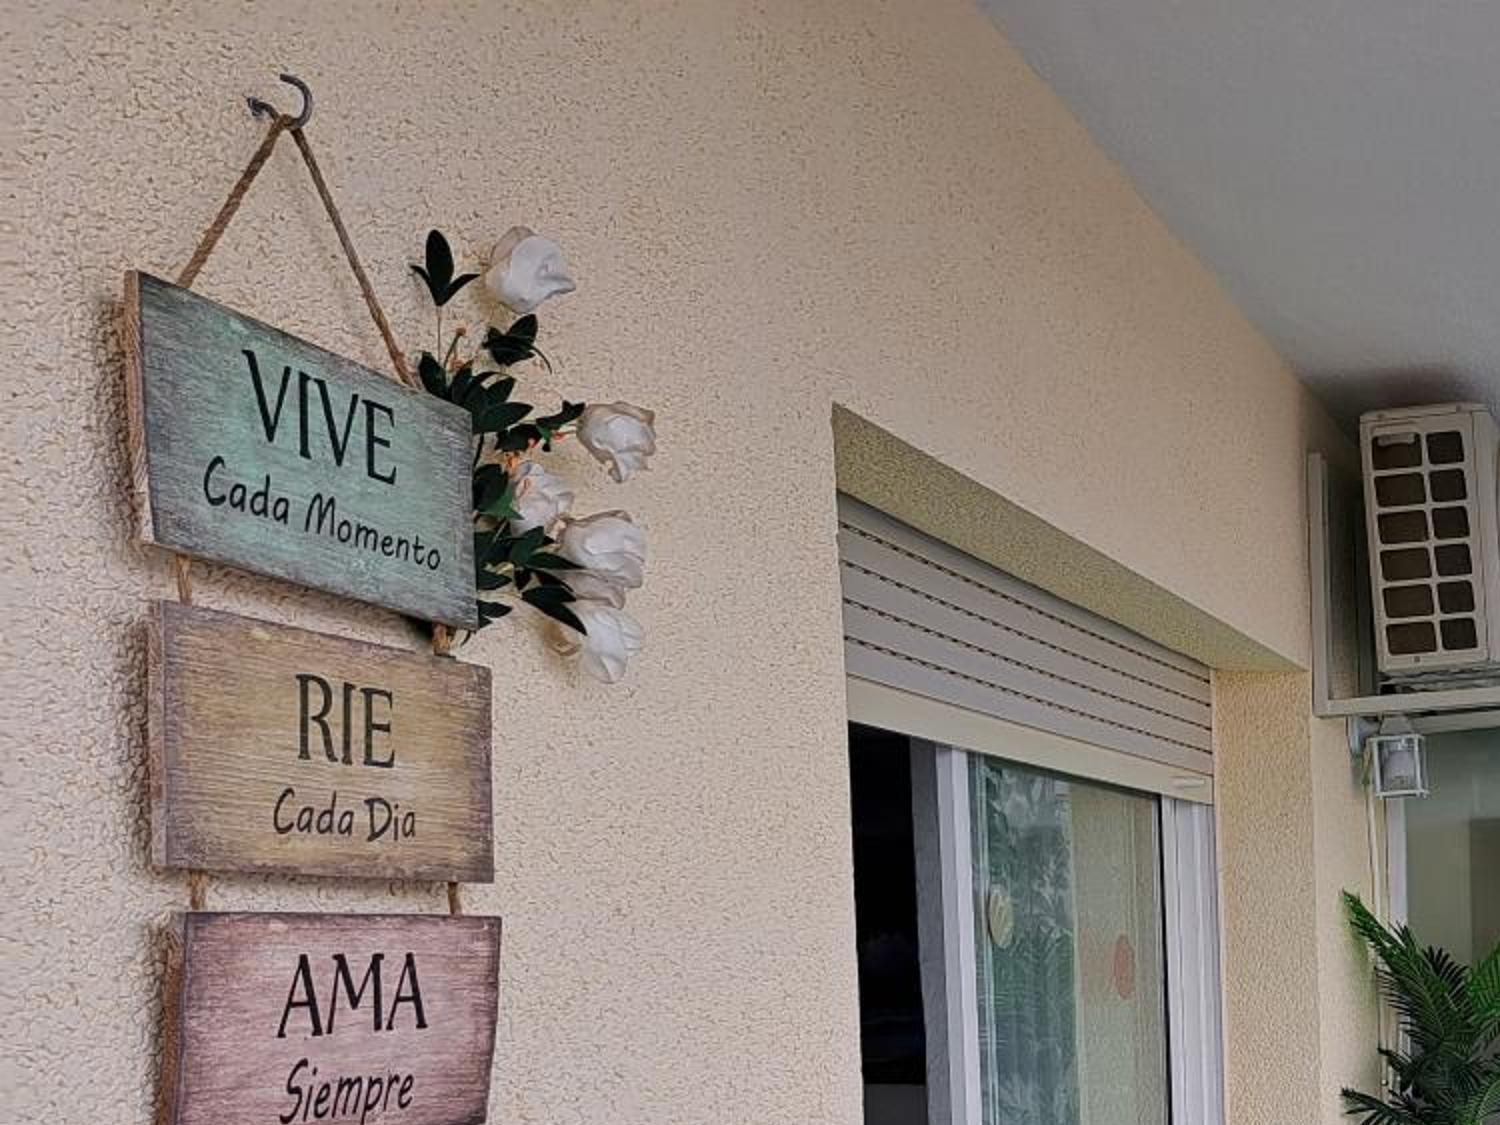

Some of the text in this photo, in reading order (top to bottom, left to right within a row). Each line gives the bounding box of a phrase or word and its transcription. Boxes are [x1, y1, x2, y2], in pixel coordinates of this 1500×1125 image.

[242, 349, 397, 485] VIVE
[203, 455, 441, 571] Cada Momento
[296, 673, 395, 768] RIE
[273, 787, 354, 837] Cada
[276, 952, 428, 1038] AMA
